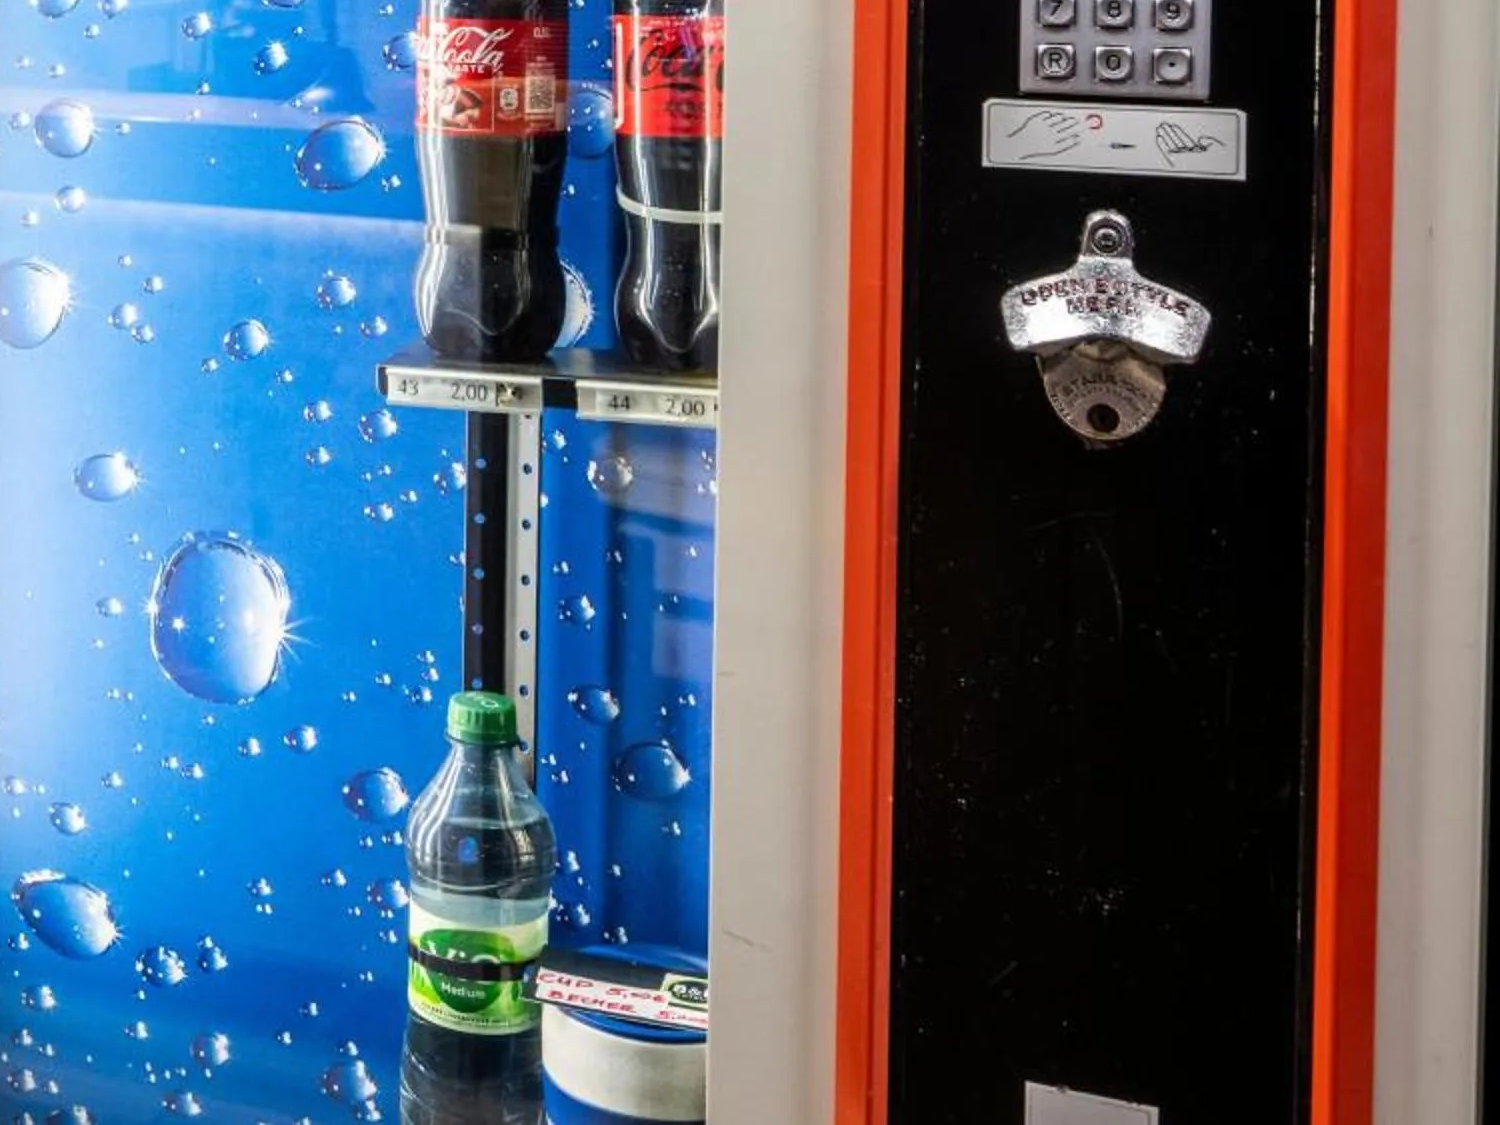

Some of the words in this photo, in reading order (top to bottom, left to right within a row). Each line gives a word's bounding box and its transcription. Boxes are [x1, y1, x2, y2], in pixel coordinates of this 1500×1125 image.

[1049, 0, 1063, 16] 7
[1107, 0, 1122, 18] 8
[1166, 1, 1180, 20] 9
[1020, 278, 1085, 306] OPEN
[397, 380, 419, 396] 43
[607, 394, 631, 412] 44
